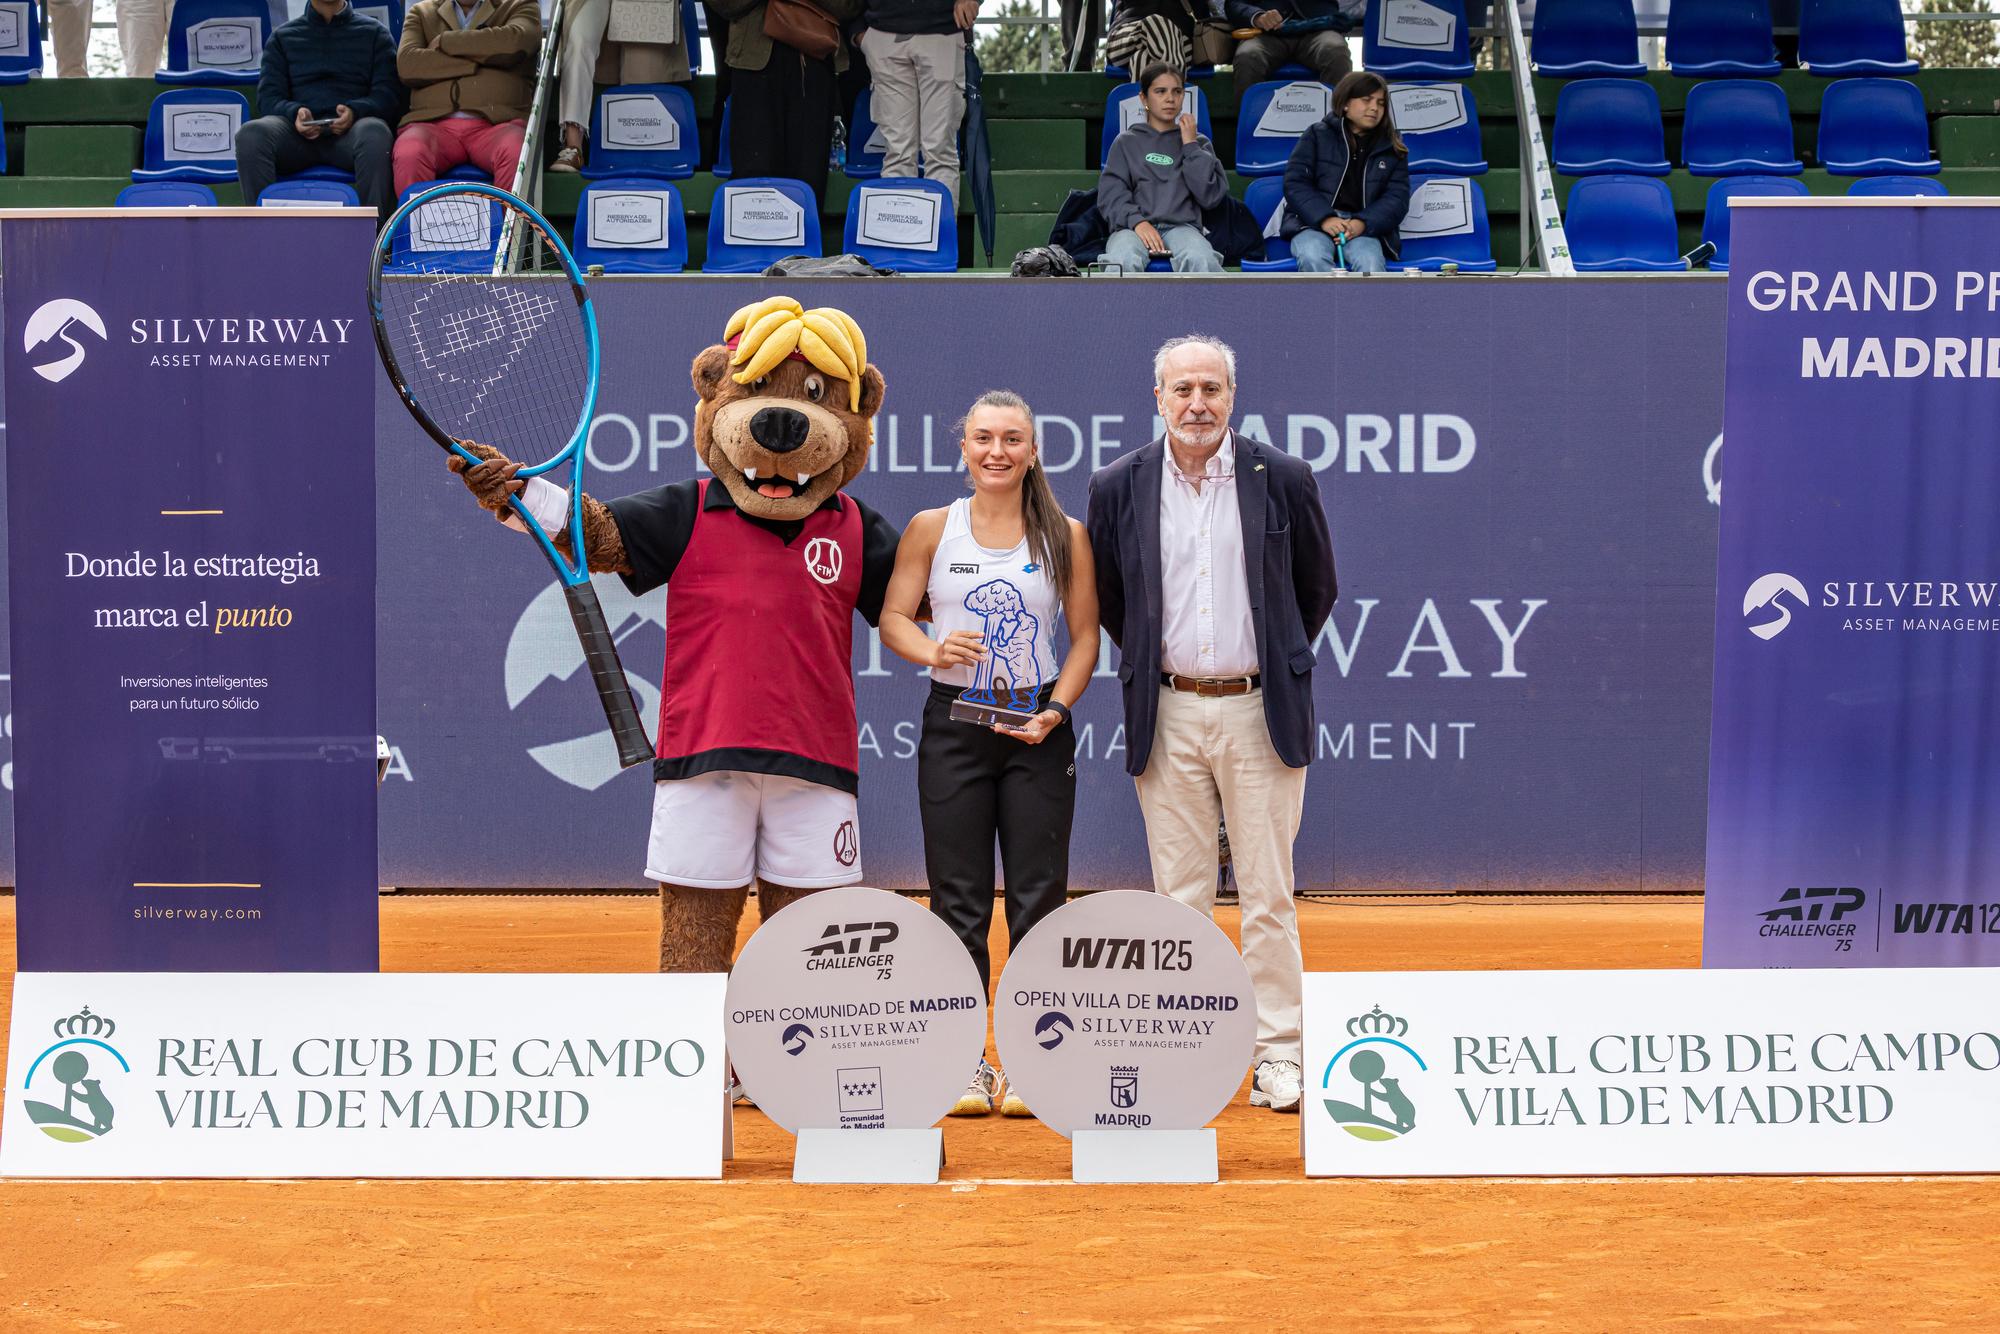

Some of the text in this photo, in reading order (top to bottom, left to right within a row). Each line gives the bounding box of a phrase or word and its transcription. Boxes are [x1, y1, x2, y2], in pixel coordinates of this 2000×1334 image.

[877, 216, 923, 225] AUTORIDADES
[878, 212, 919, 221] RESERVADO
[1746, 270, 1938, 312] GRAND
[131, 318, 354, 344] SILVERWAY
[150, 354, 330, 367] ASSET MANAGEMENT
[1035, 415, 1124, 473] DE
[65, 551, 321, 585] Donde la estrategia
[1823, 582, 2000, 607] SILVERW
[94, 600, 293, 634] marca el punto
[1843, 618, 1895, 631] ASSET
[120, 674, 269, 691] Inversiones inteligentes
[130, 697, 260, 712] para un futuro sólido
[134, 905, 261, 921] silverway.com
[1757, 887, 1866, 921] ATP
[1894, 903, 1974, 934] WTA
[801, 921, 900, 956] ATP
[1759, 923, 1857, 937] CHALLENGER
[1062, 937, 1193, 972] WTA 125
[1834, 939, 1853, 952] 75
[806, 954, 894, 971] CHALLENGER
[876, 968, 892, 980] 75
[732, 996, 977, 1024] OPEN COMUNIDAD DE MADRID
[1014, 990, 1239, 1012] OPEN VILLA DE MADRID
[820, 1019, 929, 1039] SILVERWAY
[1082, 1017, 1215, 1036] SILVERWAY
[831, 1037, 921, 1050] ASSET MANAGEMENT
[1093, 1039, 1203, 1049] ASSET MANAGEMENT
[156, 1038, 705, 1077] REAL CLUB DE CAMPO
[1453, 1032, 2000, 1075] REAL CLUB DE CAMPO
[156, 1089, 590, 1129] VILLA DE MADRID
[1455, 1085, 1894, 1126] VILLA DE MADRID
[840, 1113, 885, 1122] Comunidad
[854, 1121, 885, 1129] Madrid
[1095, 1113, 1152, 1129] MADRID
